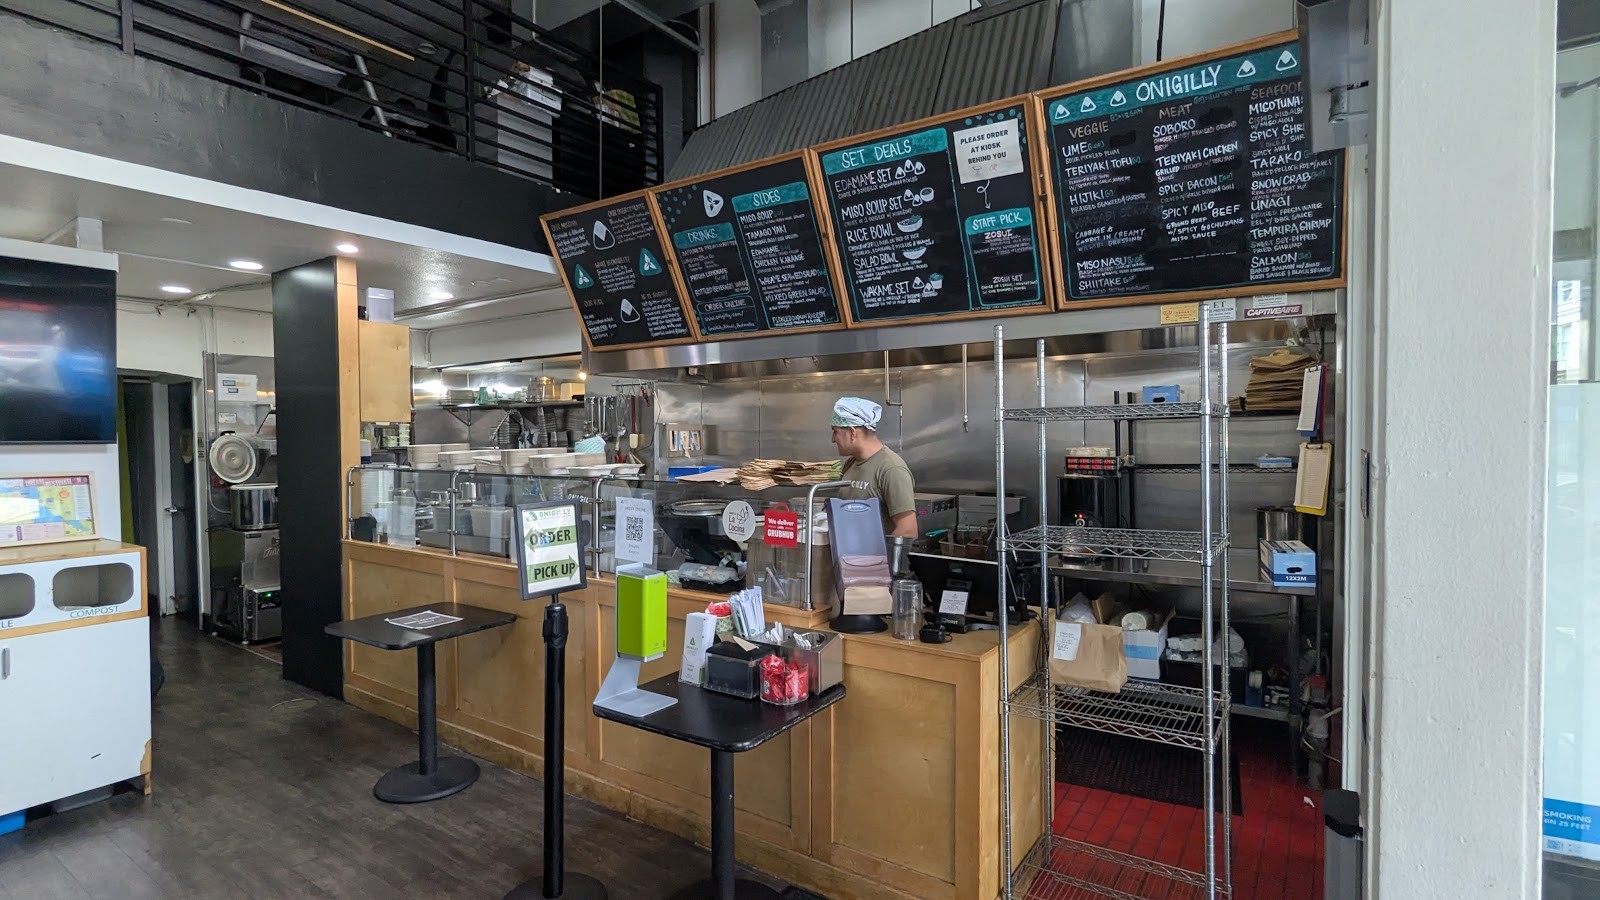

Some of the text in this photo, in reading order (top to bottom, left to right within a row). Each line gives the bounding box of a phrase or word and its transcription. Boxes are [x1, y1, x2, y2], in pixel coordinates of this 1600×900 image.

[1136, 65, 1222, 102] ONIGILLY
[1159, 103, 1193, 119] MEAT
[1069, 121, 1109, 138] VEGGIE
[1152, 119, 1196, 138] SOBORO
[1249, 127, 1279, 142] SPICY
[960, 129, 1009, 145] PLEASE ORDER
[841, 140, 912, 168] SET DEALS
[970, 141, 1002, 154] AT KIOSK
[1062, 142, 1088, 158] UME
[1155, 149, 1202, 168] TERIYAKI
[1202, 141, 1238, 159] CHICKEN
[1252, 149, 1271, 158] SPICY
[968, 151, 1007, 165] BEHIND YOU
[1250, 151, 1301, 169] TARAKO
[1065, 160, 1110, 177] TERIYAKI
[1111, 157, 1133, 169] TOFU
[1155, 165, 1180, 177] GRILLED
[834, 171, 876, 193] EDAMAME
[876, 168, 892, 183] SET
[1158, 176, 1217, 196] SPICY BACON
[753, 190, 781, 207] SIDES
[1069, 190, 1104, 206] HIJIKI
[1250, 195, 1291, 212] UNAGI
[841, 203, 864, 220] MISO
[866, 199, 888, 216] SOUP
[889, 196, 903, 211] SET
[1161, 201, 1215, 220] SPICY MISO
[1211, 204, 1241, 218] BEEF
[1292, 211, 1313, 220] SAUCE
[740, 213, 757, 225] MISO
[757, 209, 773, 221] SOUP
[972, 212, 1023, 230] STAFF PICK
[1166, 216, 1208, 230] GROUND BEEF
[745, 228, 772, 241] TAMAGO
[772, 225, 787, 234] YAKI
[846, 223, 897, 244] RICE BOWL
[1075, 227, 1106, 240] CABBAGE
[1113, 228, 1146, 239] CREAMY
[1177, 217, 1244, 235] SPICY GOCHUJANG
[1250, 218, 1332, 240] TEMPURA SHRIMP
[688, 228, 718, 243] DRINKS
[984, 229, 1013, 240] ZOSUI
[1107, 236, 1143, 247] DRESSING
[1170, 230, 1217, 243] MISO SAUCE
[751, 245, 780, 257] EDAMAME
[754, 257, 779, 269] CHICKEN
[853, 252, 899, 270] SALAD BOWL
[1077, 256, 1127, 271] MISO NASU
[1251, 252, 1298, 268] SALMON
[1250, 263, 1295, 274] BAKED SALMON
[859, 281, 910, 299] WAKAME SET
[1078, 277, 1122, 291] SHIITAKE
[765, 293, 787, 302] MIXED
[787, 290, 808, 299] GREEN
[808, 287, 826, 296] SALAD
[704, 299, 746, 311] ORDER ONLINE
[539, 507, 572, 518] ONIGILY
[728, 523, 745, 533] Cocina
[768, 517, 794, 527] We deliver
[529, 529, 571, 546] ORDER
[767, 529, 794, 540] GRUBHUB
[534, 562, 576, 580] PICK UP
[70, 605, 120, 619] COMPOST
[1544, 809, 1592, 824] SMOKING
[1570, 822, 1591, 830] FEET
